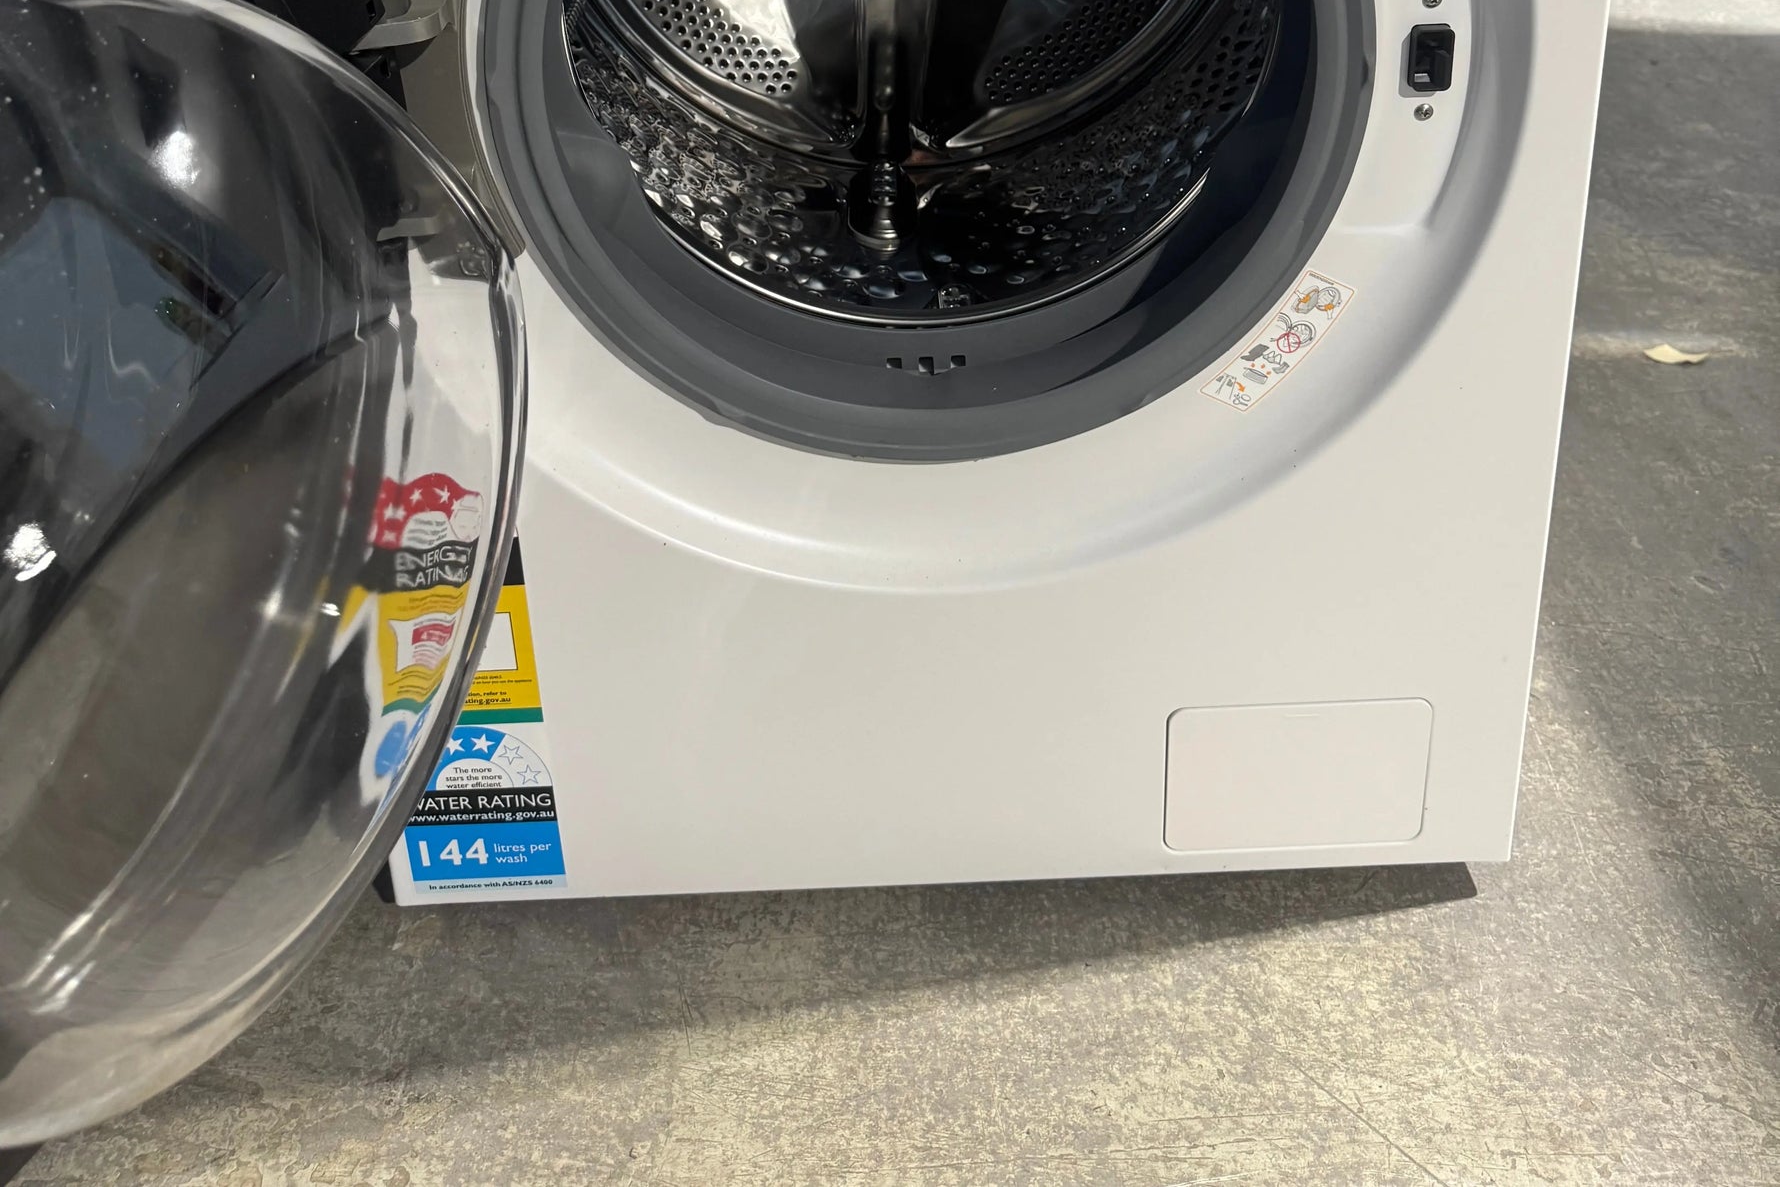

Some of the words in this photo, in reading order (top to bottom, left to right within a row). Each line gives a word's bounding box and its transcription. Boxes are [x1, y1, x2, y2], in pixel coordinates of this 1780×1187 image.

[478, 793, 552, 809] RATING
[493, 843, 526, 853] litres
[530, 842, 552, 855] per
[496, 853, 528, 864] wash
[438, 883, 483, 891] accordance
[484, 881, 501, 889] with
[501, 880, 533, 888] AS/NZS
[534, 878, 553, 886] 6400
